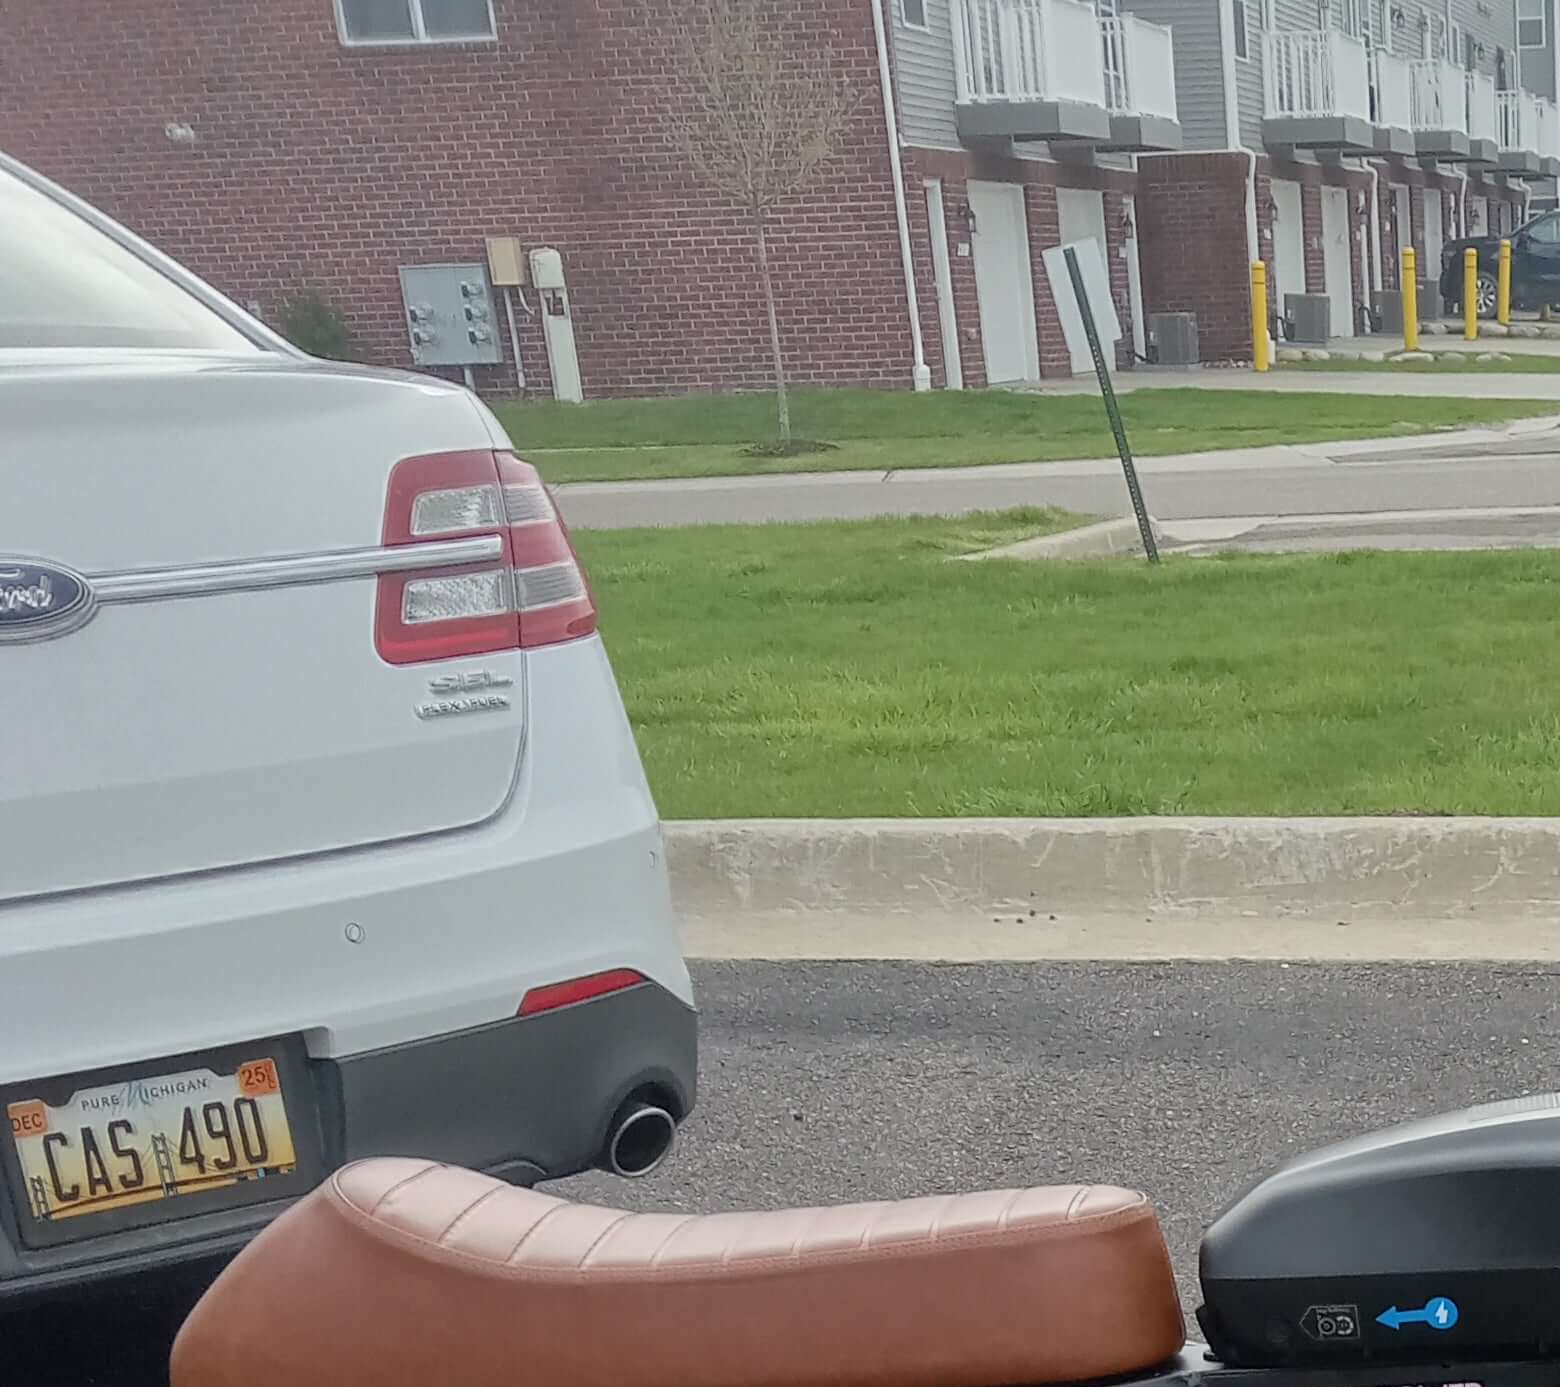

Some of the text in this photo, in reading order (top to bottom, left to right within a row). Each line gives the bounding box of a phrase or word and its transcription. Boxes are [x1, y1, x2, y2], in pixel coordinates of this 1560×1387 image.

[429, 671, 514, 695] SEL
[241, 1066, 266, 1087] 25
[80, 1079, 209, 1111] PURE MICHIGAN
[12, 1112, 43, 1132] DEC
[43, 1098, 269, 1201] CAS 490
